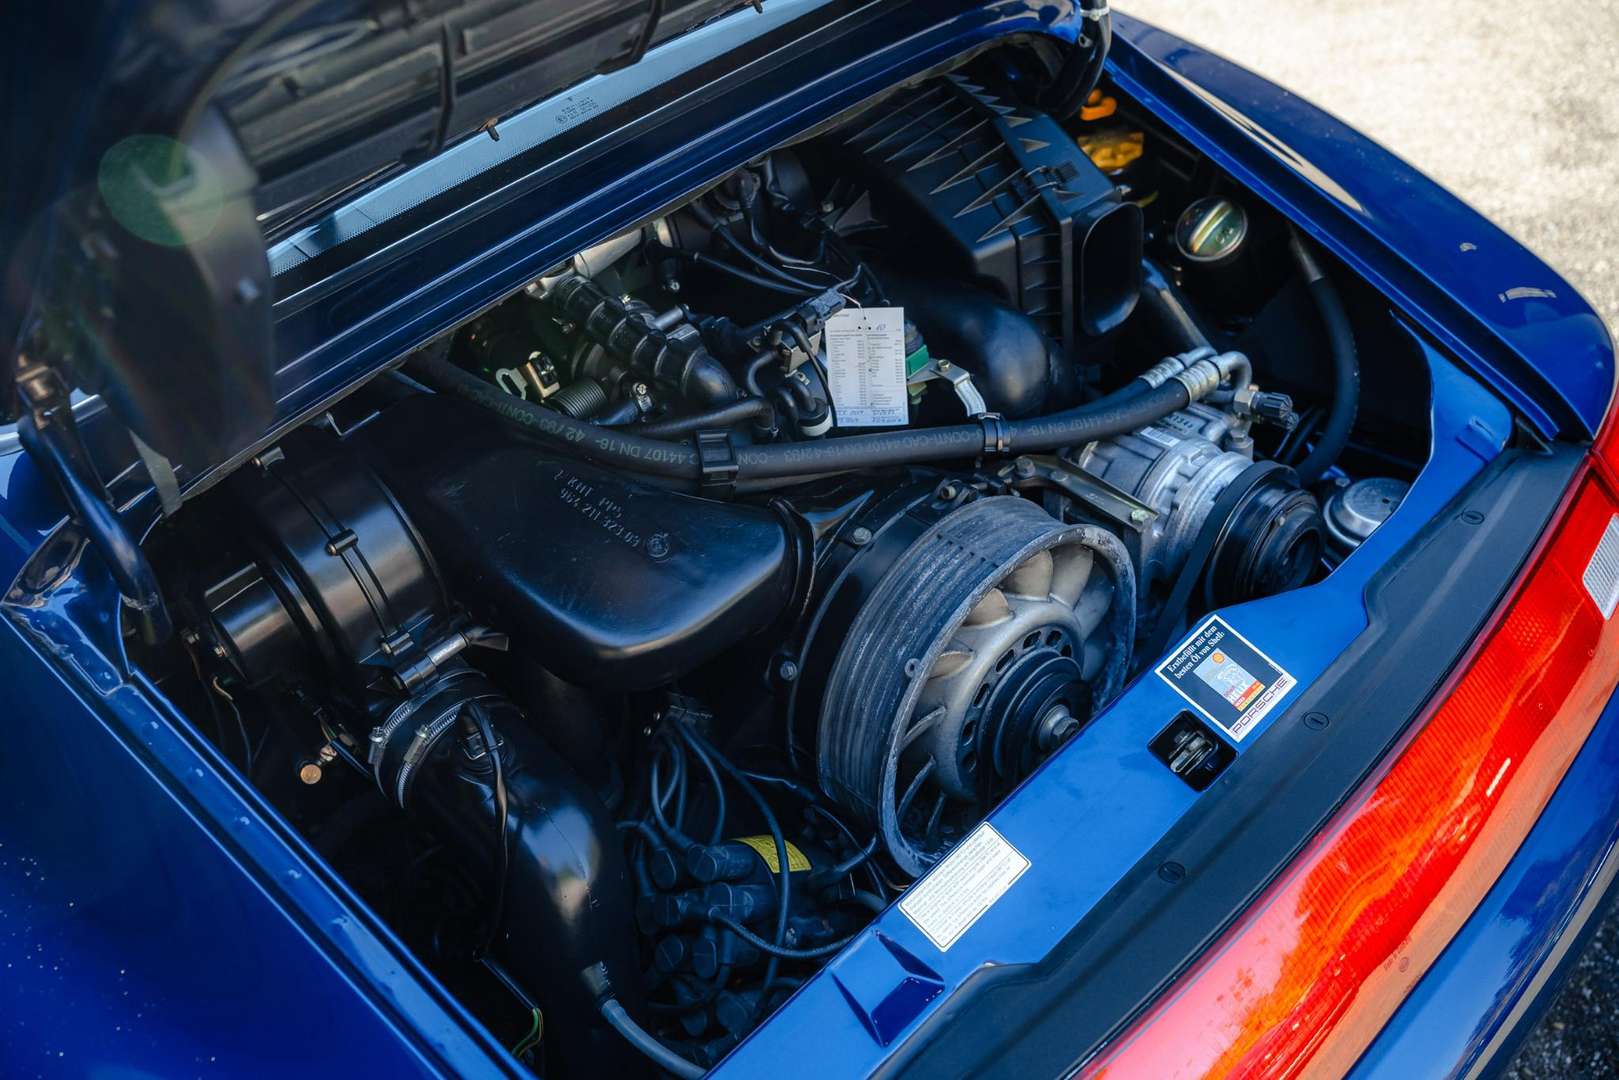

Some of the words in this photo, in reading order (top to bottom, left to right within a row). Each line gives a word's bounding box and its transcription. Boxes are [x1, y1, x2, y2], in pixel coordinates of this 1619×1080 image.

[621, 442, 641, 458] DN
[644, 451, 686, 464] 44107
[1167, 643, 1197, 672] Erstbefüllt
[1195, 635, 1206, 647] mit
[1204, 625, 1217, 638] dem
[1174, 661, 1193, 680] besten
[1191, 650, 1201, 663] Öl
[1199, 644, 1211, 656] von
[1232, 678, 1288, 734] PORSCHE
